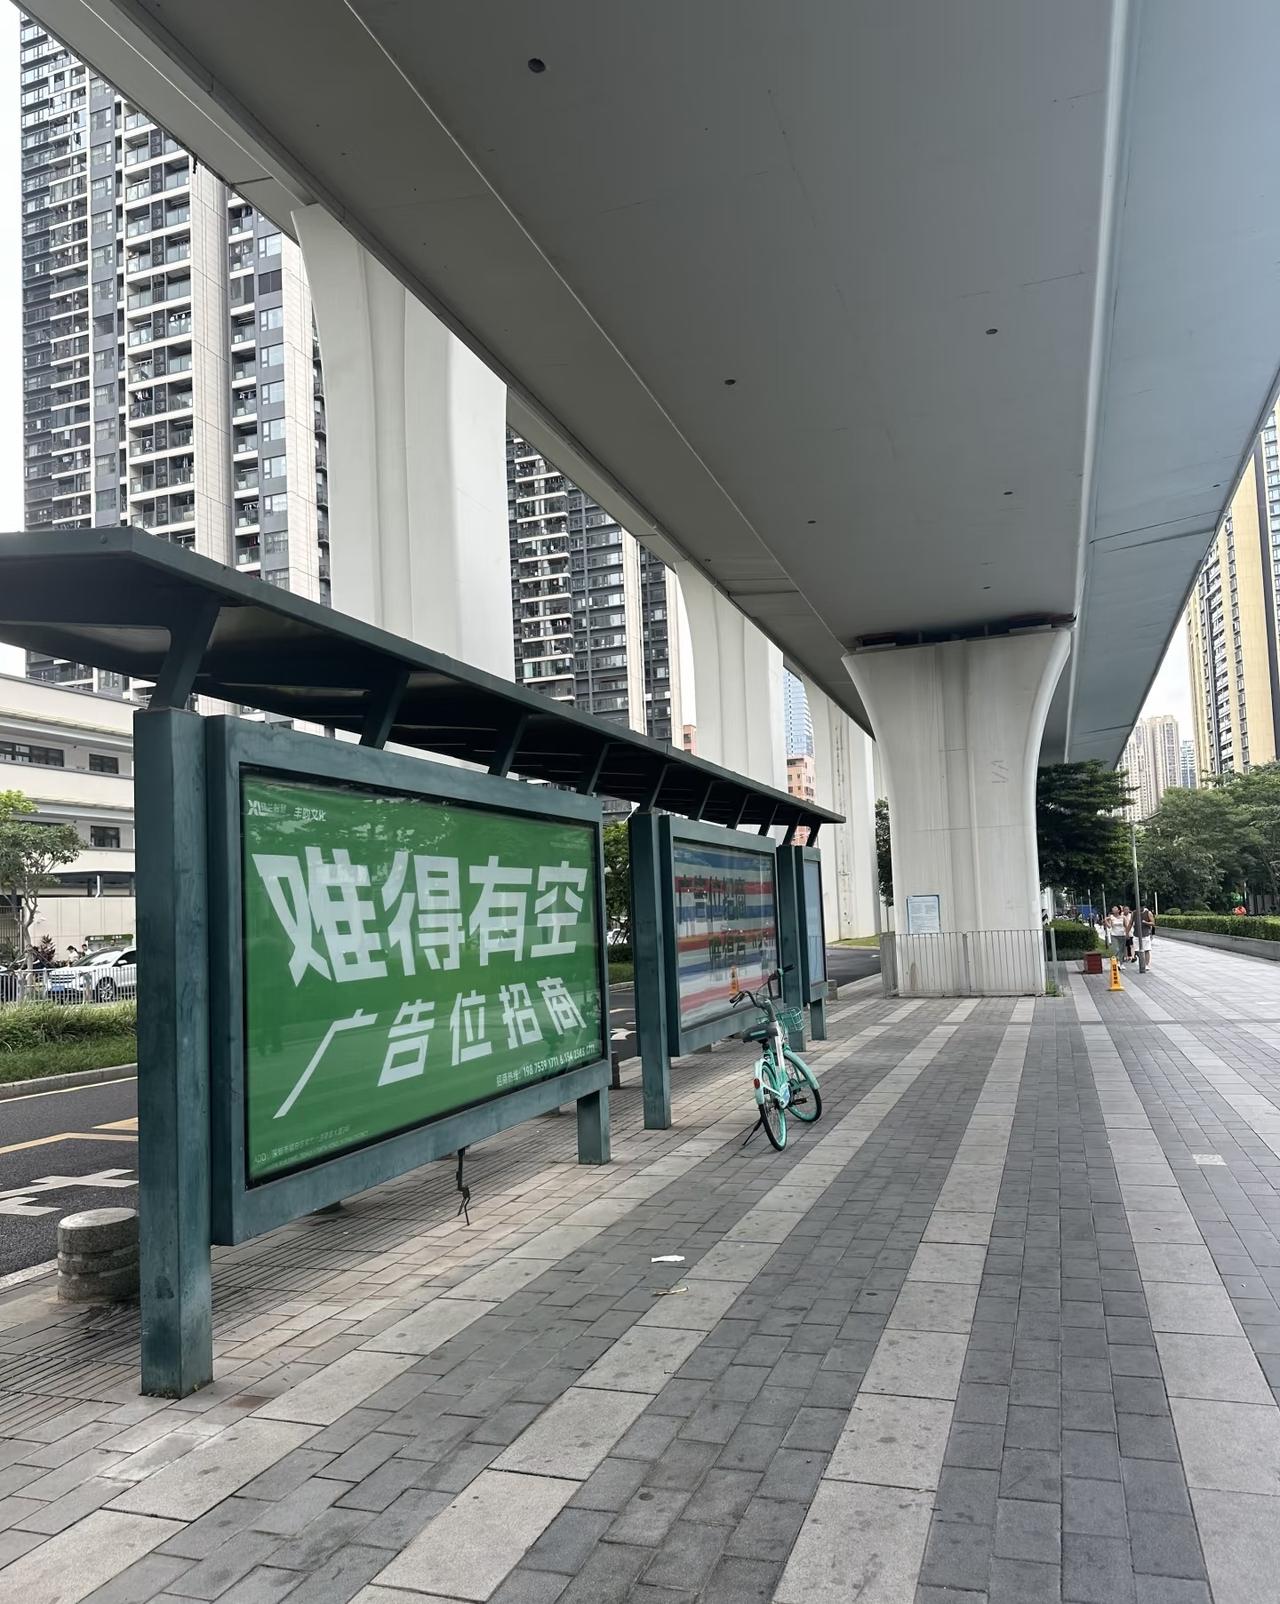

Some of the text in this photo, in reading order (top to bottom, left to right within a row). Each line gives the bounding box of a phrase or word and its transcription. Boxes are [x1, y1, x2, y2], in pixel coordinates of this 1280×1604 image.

[251, 846, 588, 988] 难得有空
[272, 976, 588, 1120] 广告位招商
